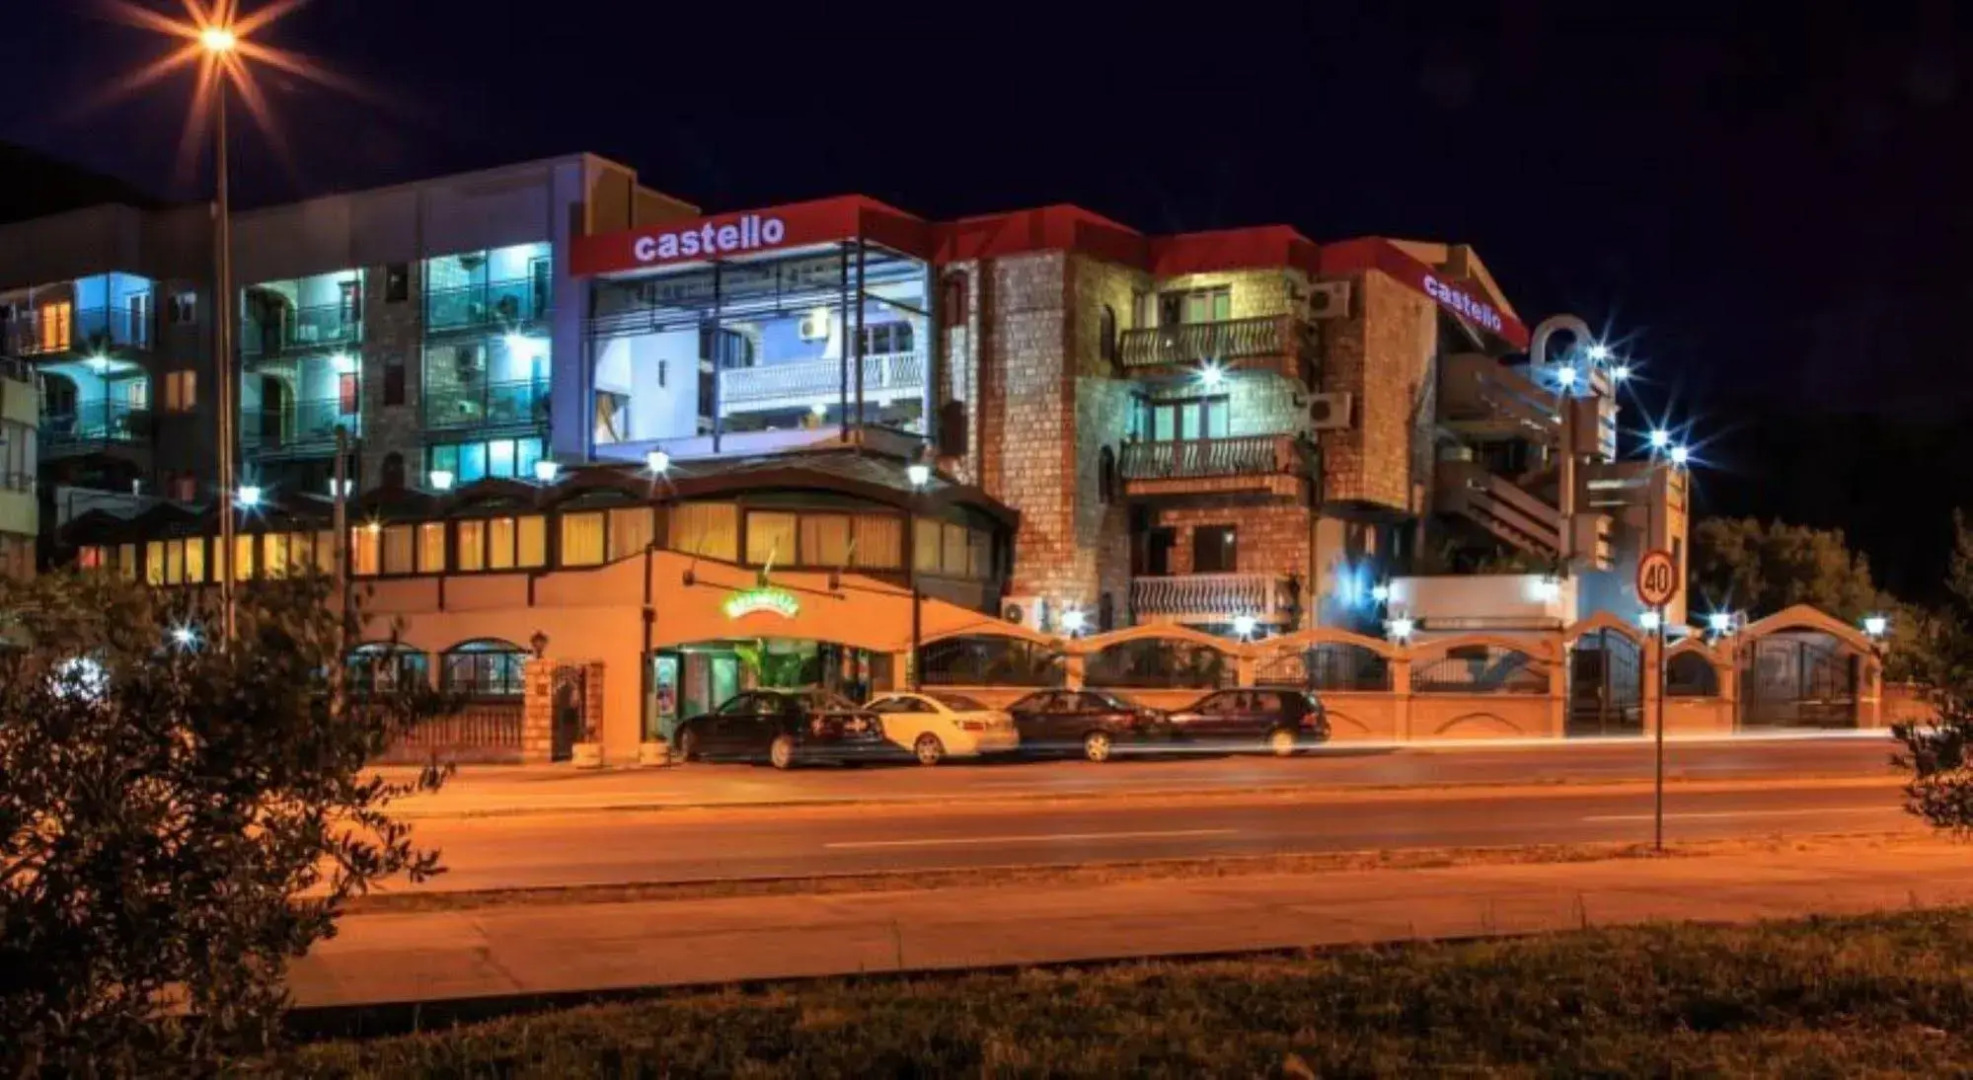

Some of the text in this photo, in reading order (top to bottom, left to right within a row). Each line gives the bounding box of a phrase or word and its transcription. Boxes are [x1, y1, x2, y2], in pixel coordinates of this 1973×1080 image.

[634, 214, 785, 261] castello
[1423, 274, 1502, 331] castello
[1644, 563, 1669, 593] 40
